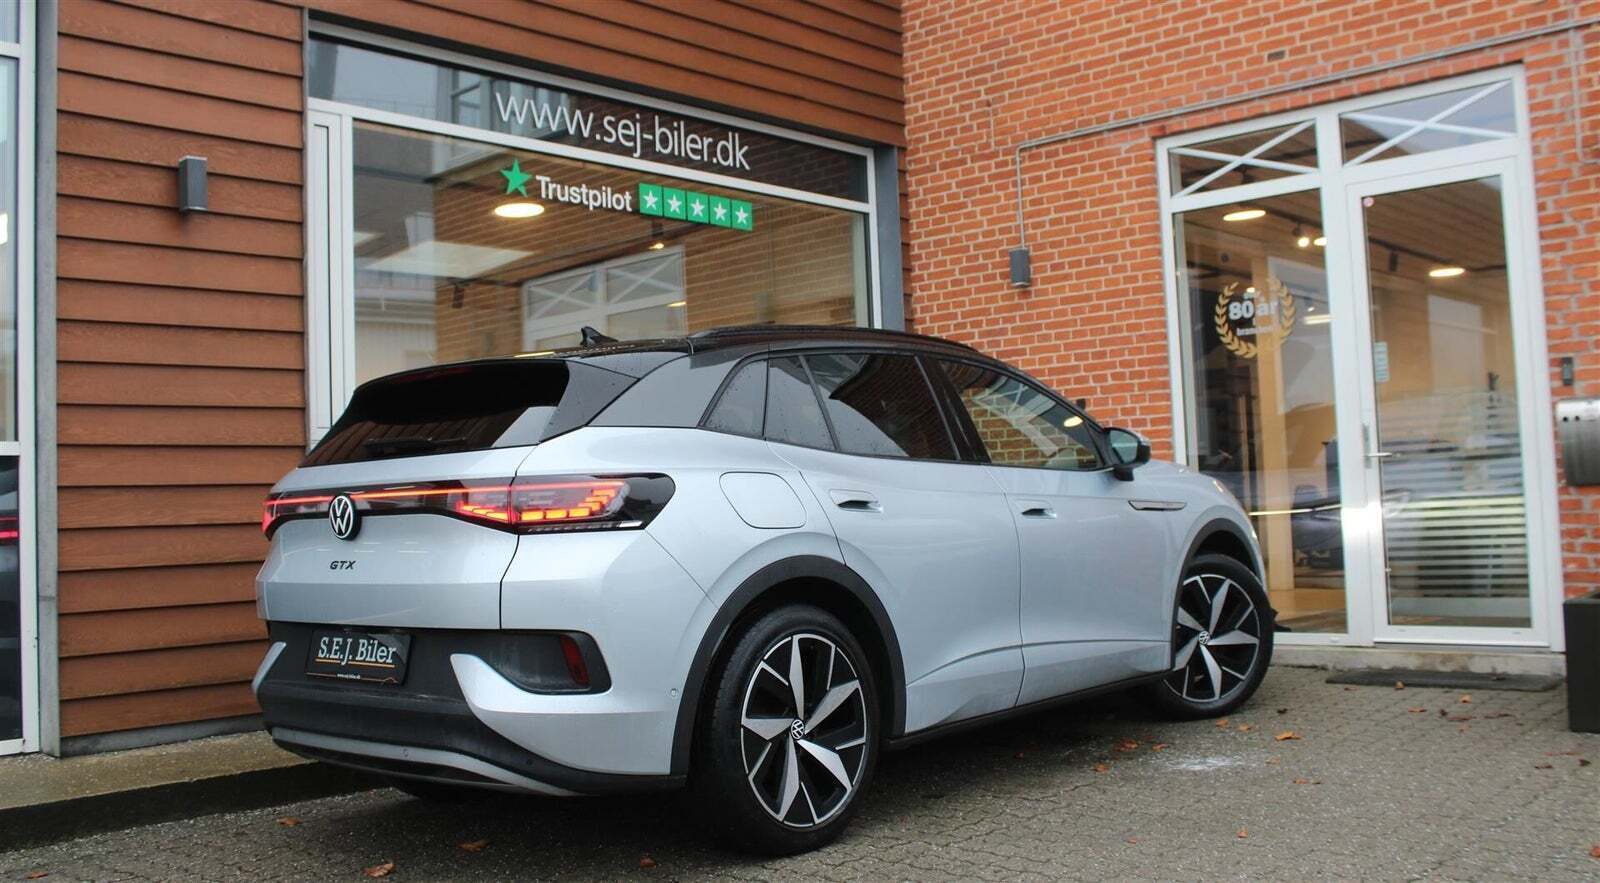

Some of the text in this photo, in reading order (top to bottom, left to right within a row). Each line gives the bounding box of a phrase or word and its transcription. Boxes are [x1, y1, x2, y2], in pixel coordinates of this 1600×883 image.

[496, 92, 751, 170] www.sej-biler.dk
[535, 175, 633, 212] Trustpilot
[1228, 301, 1254, 320] 80
[329, 495, 353, 538] VW
[329, 560, 356, 570] GTX
[318, 637, 397, 665] S.E.J. Biler
